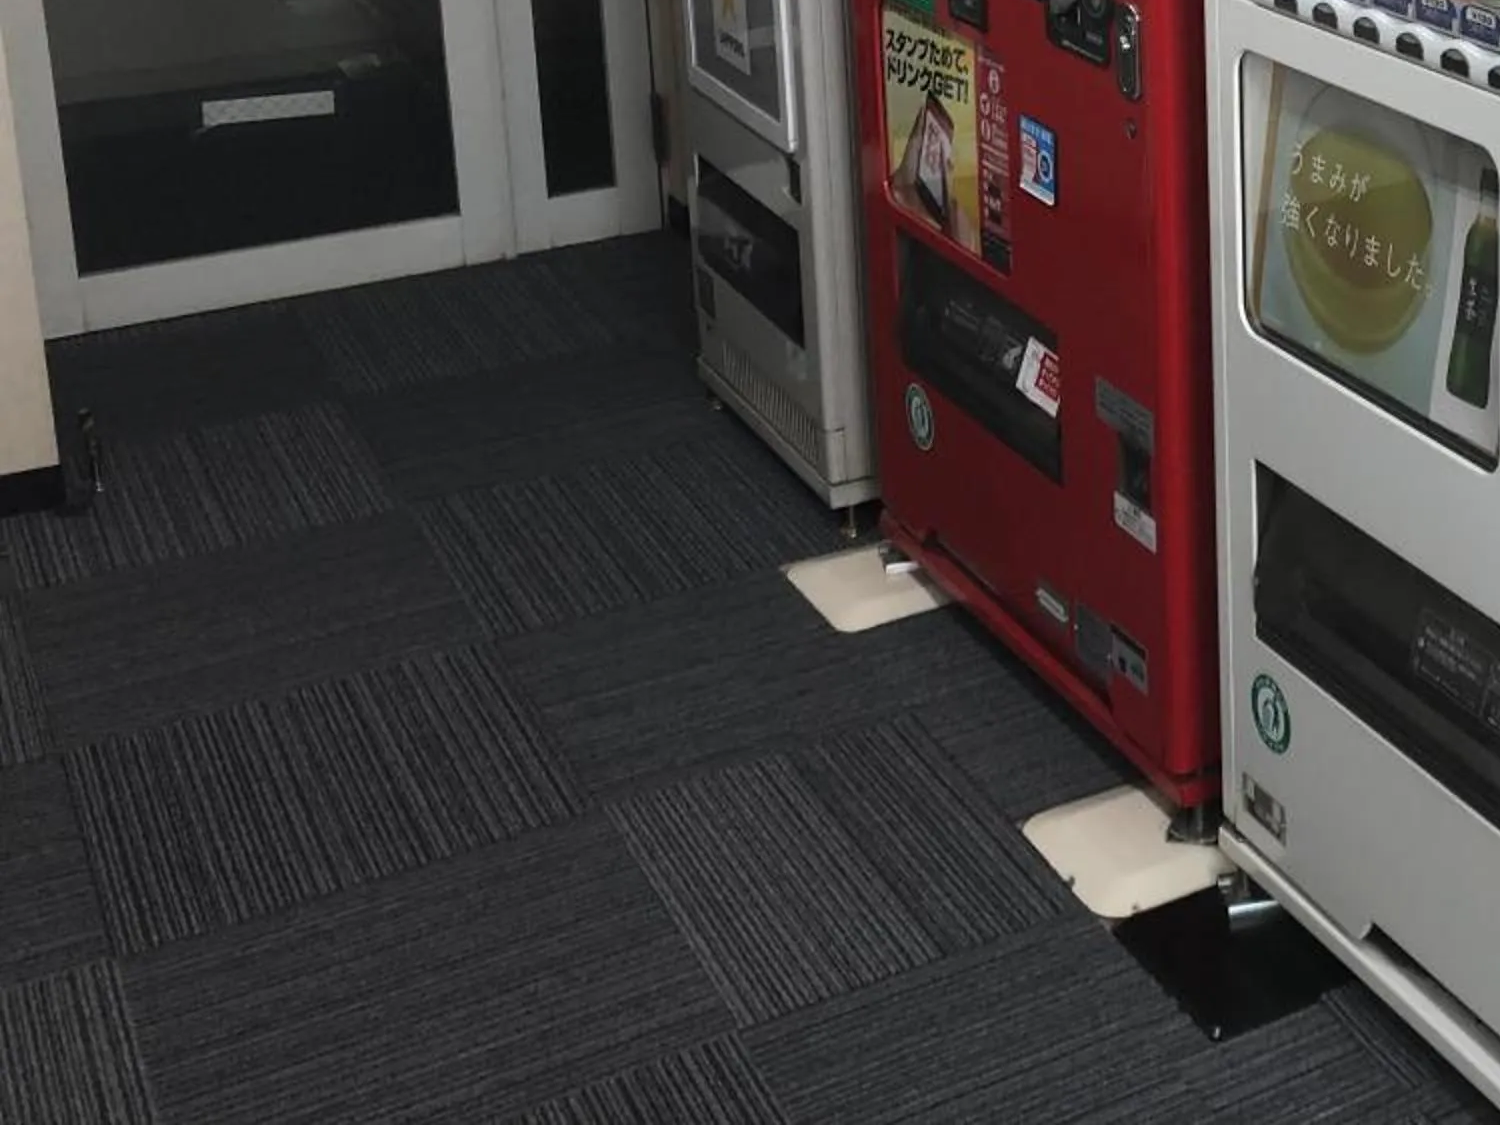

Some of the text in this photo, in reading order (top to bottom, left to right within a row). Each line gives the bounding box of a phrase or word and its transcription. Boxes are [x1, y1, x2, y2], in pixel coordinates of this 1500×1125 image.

[885, 28, 969, 76] スタンプためて、
[886, 56, 969, 105] ドリンクGET!
[1291, 141, 1371, 202] うまみが
[1280, 192, 1433, 299] 強くなりました。
